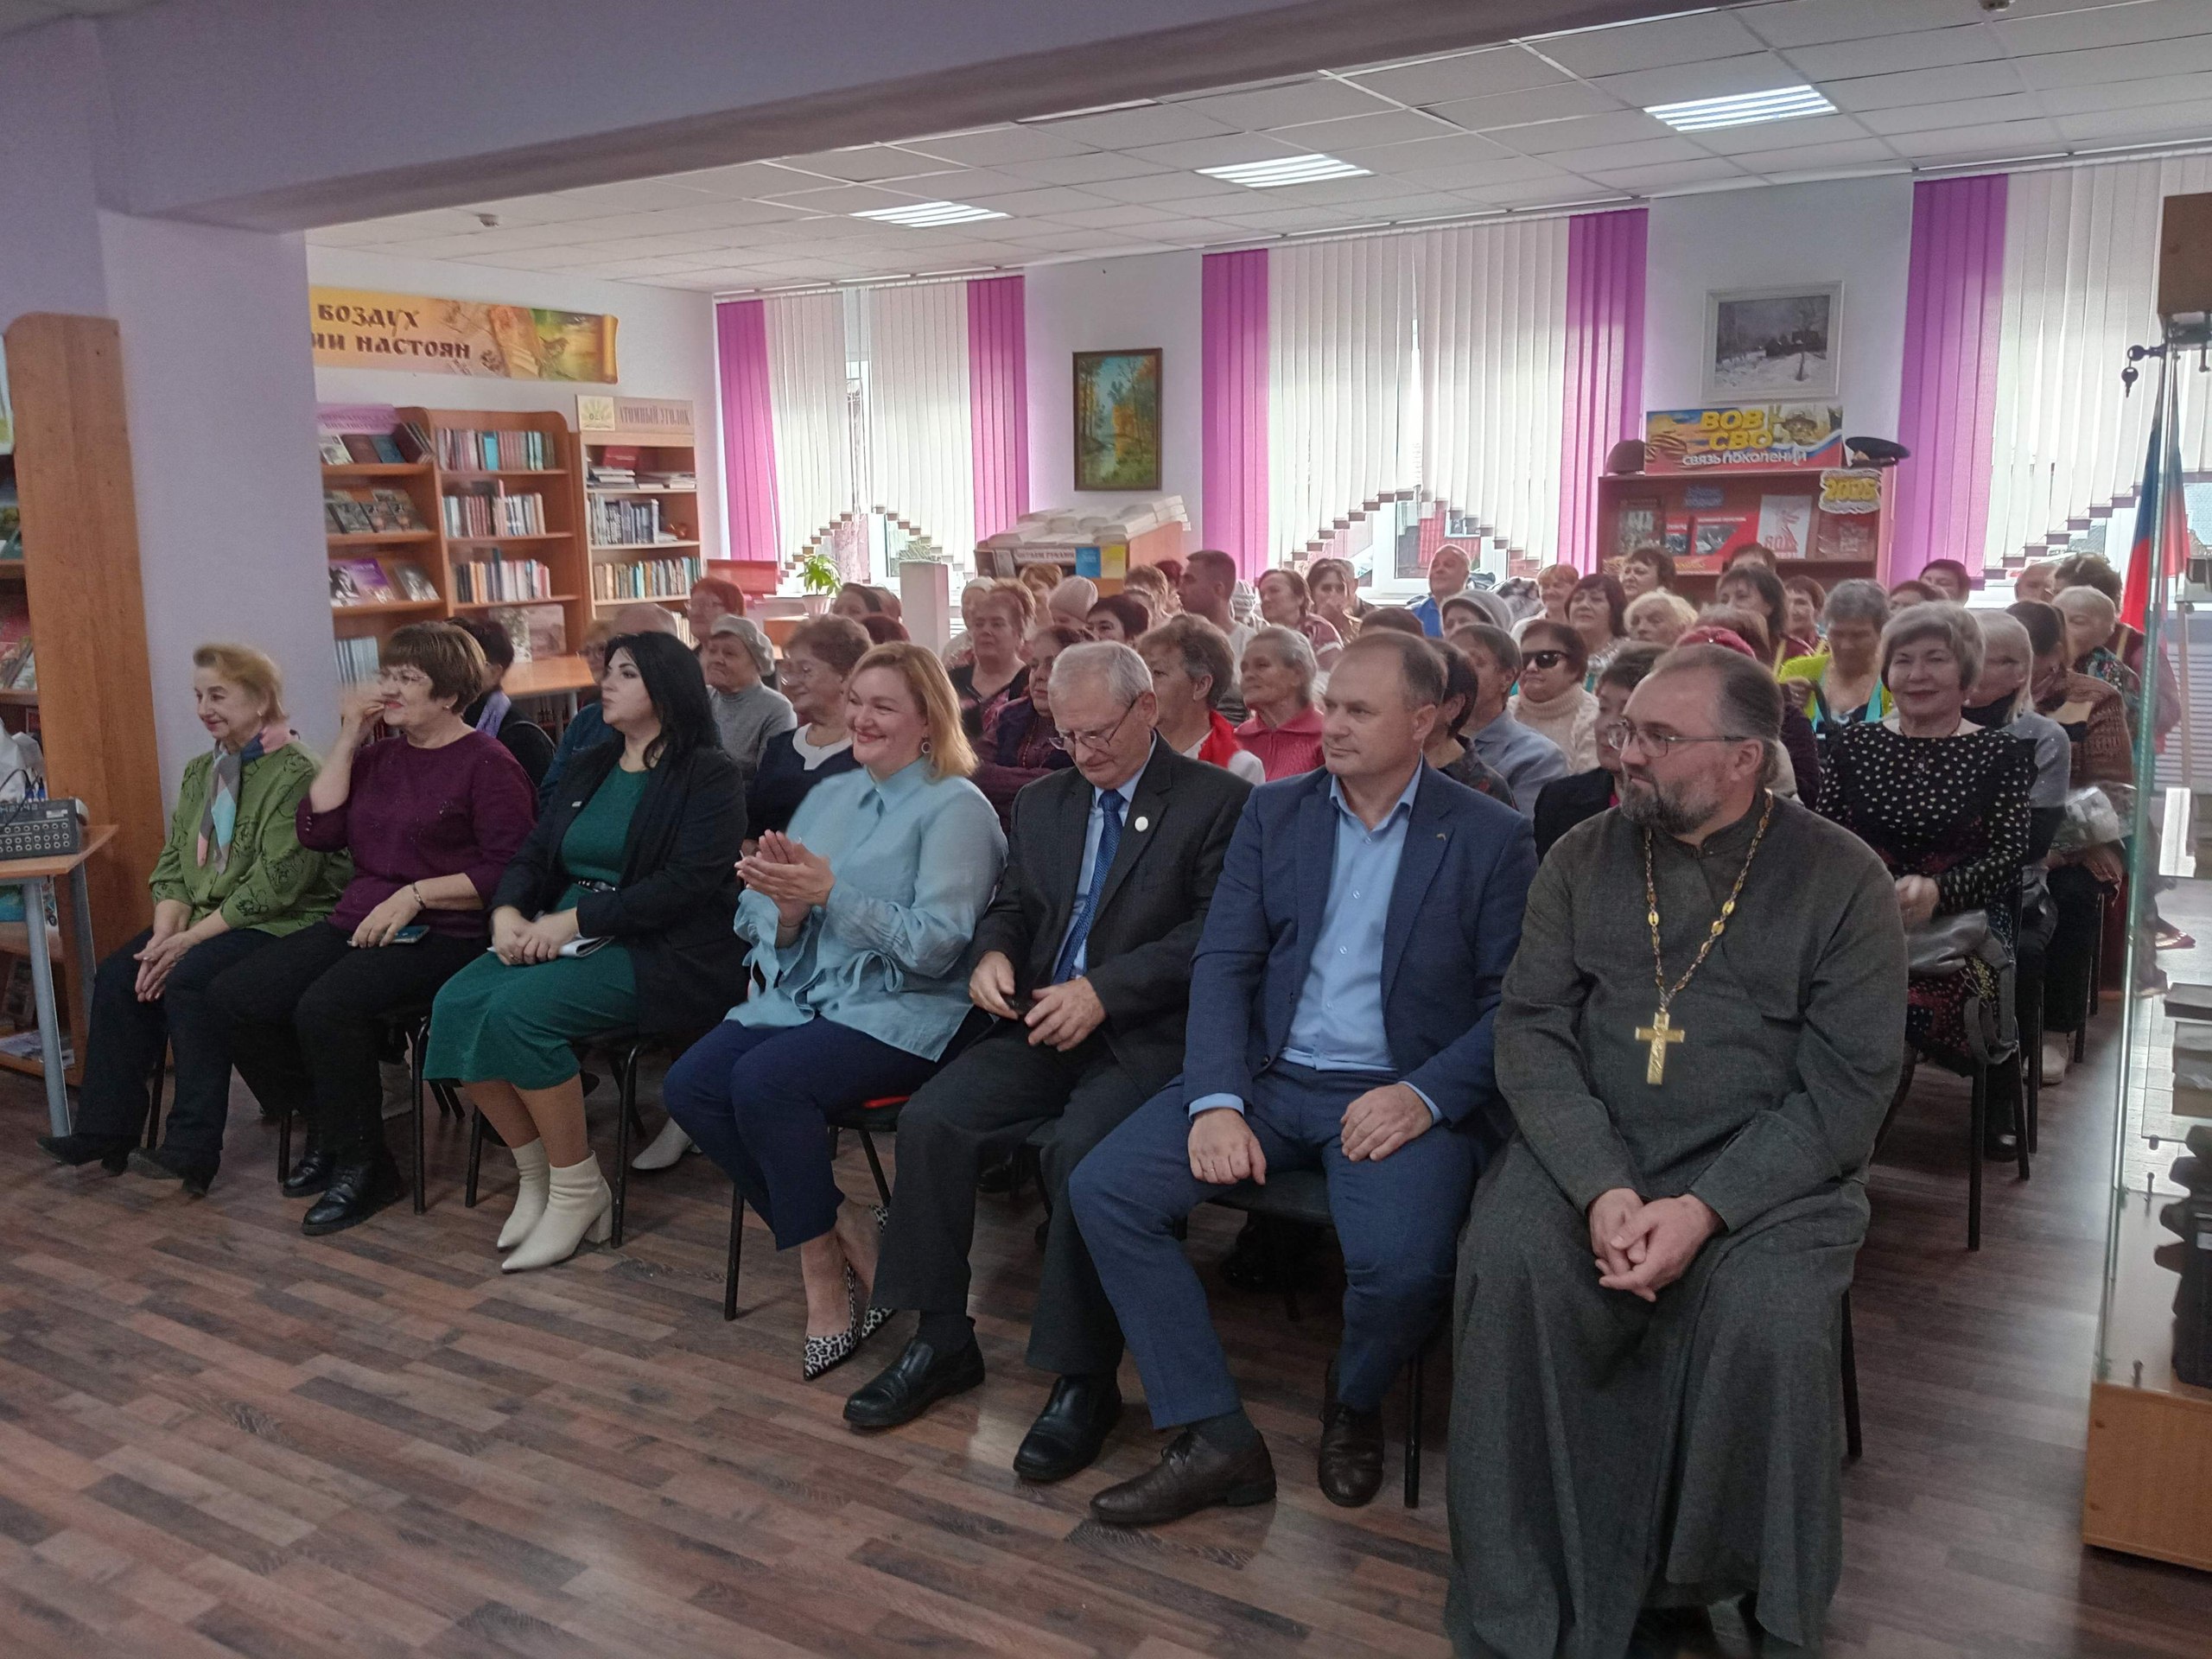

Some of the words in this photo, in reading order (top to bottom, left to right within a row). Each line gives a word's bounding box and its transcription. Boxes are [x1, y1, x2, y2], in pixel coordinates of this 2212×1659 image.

[355, 335, 471, 359] НАСТОЯН
[1700, 409, 1765, 431] ВОВ
[1708, 429, 1773, 451] СВО
